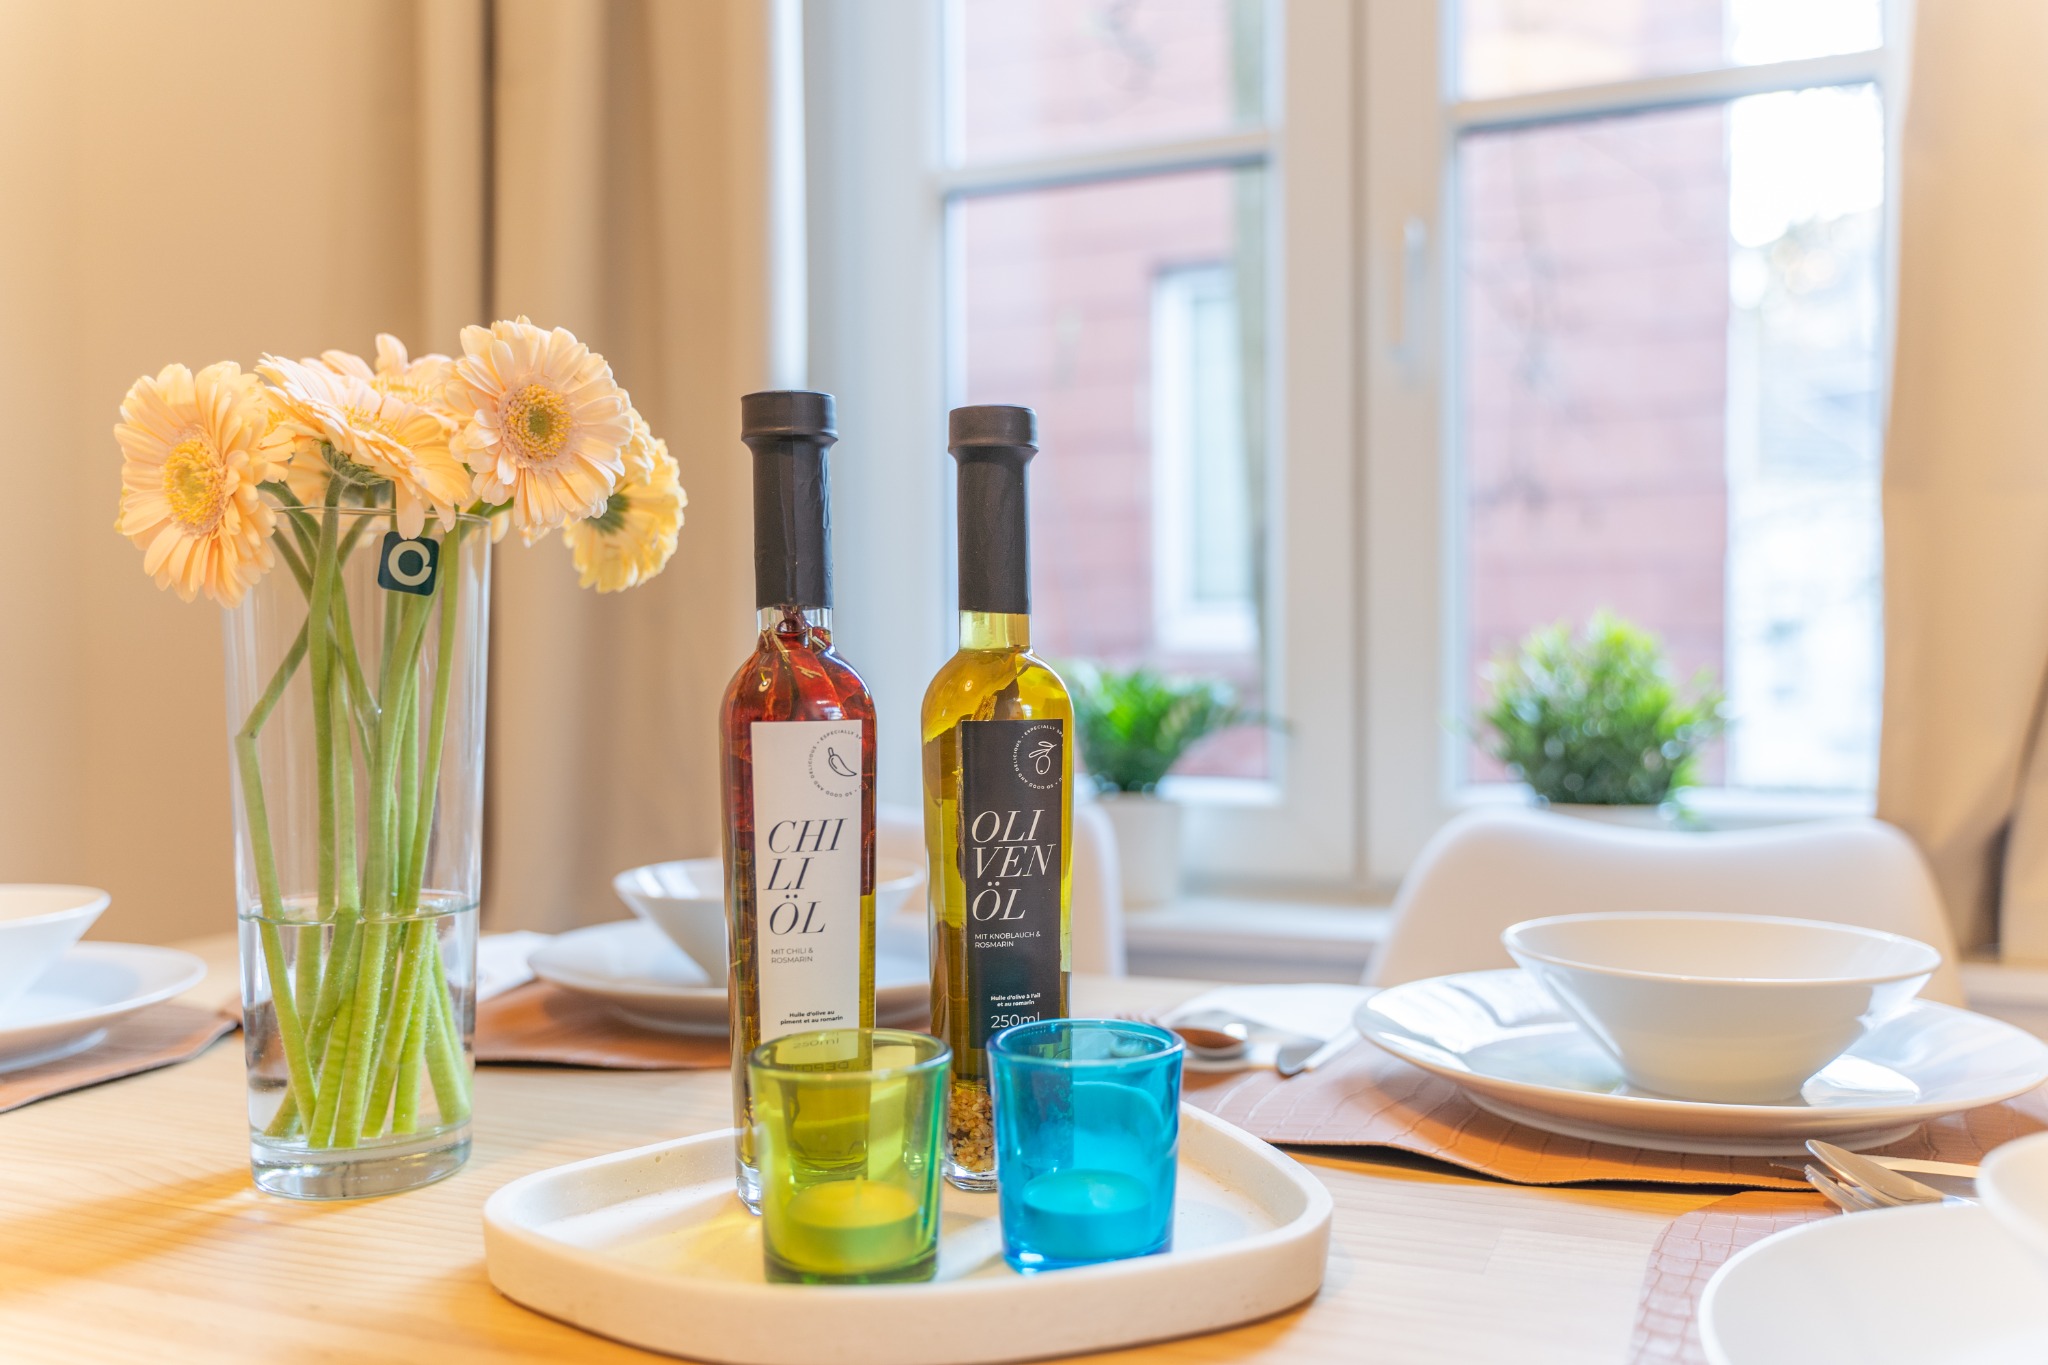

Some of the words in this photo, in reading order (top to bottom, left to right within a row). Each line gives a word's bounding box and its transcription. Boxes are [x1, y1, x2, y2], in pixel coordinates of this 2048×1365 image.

[1024, 724, 1056, 736] ESPECIALLY
[768, 817, 849, 854] CHI
[971, 809, 1045, 843] OLI
[763, 856, 815, 891] LI
[972, 843, 1057, 879] VEN
[972, 881, 1026, 921] ÖL
[769, 894, 826, 936] ÖL
[989, 931, 1035, 940] KNOBLAUCH
[771, 955, 814, 964] ROSMARIN
[786, 947, 807, 955] CHILI
[780, 1018, 802, 1026] piment
[990, 1012, 1040, 1029] 250ml
